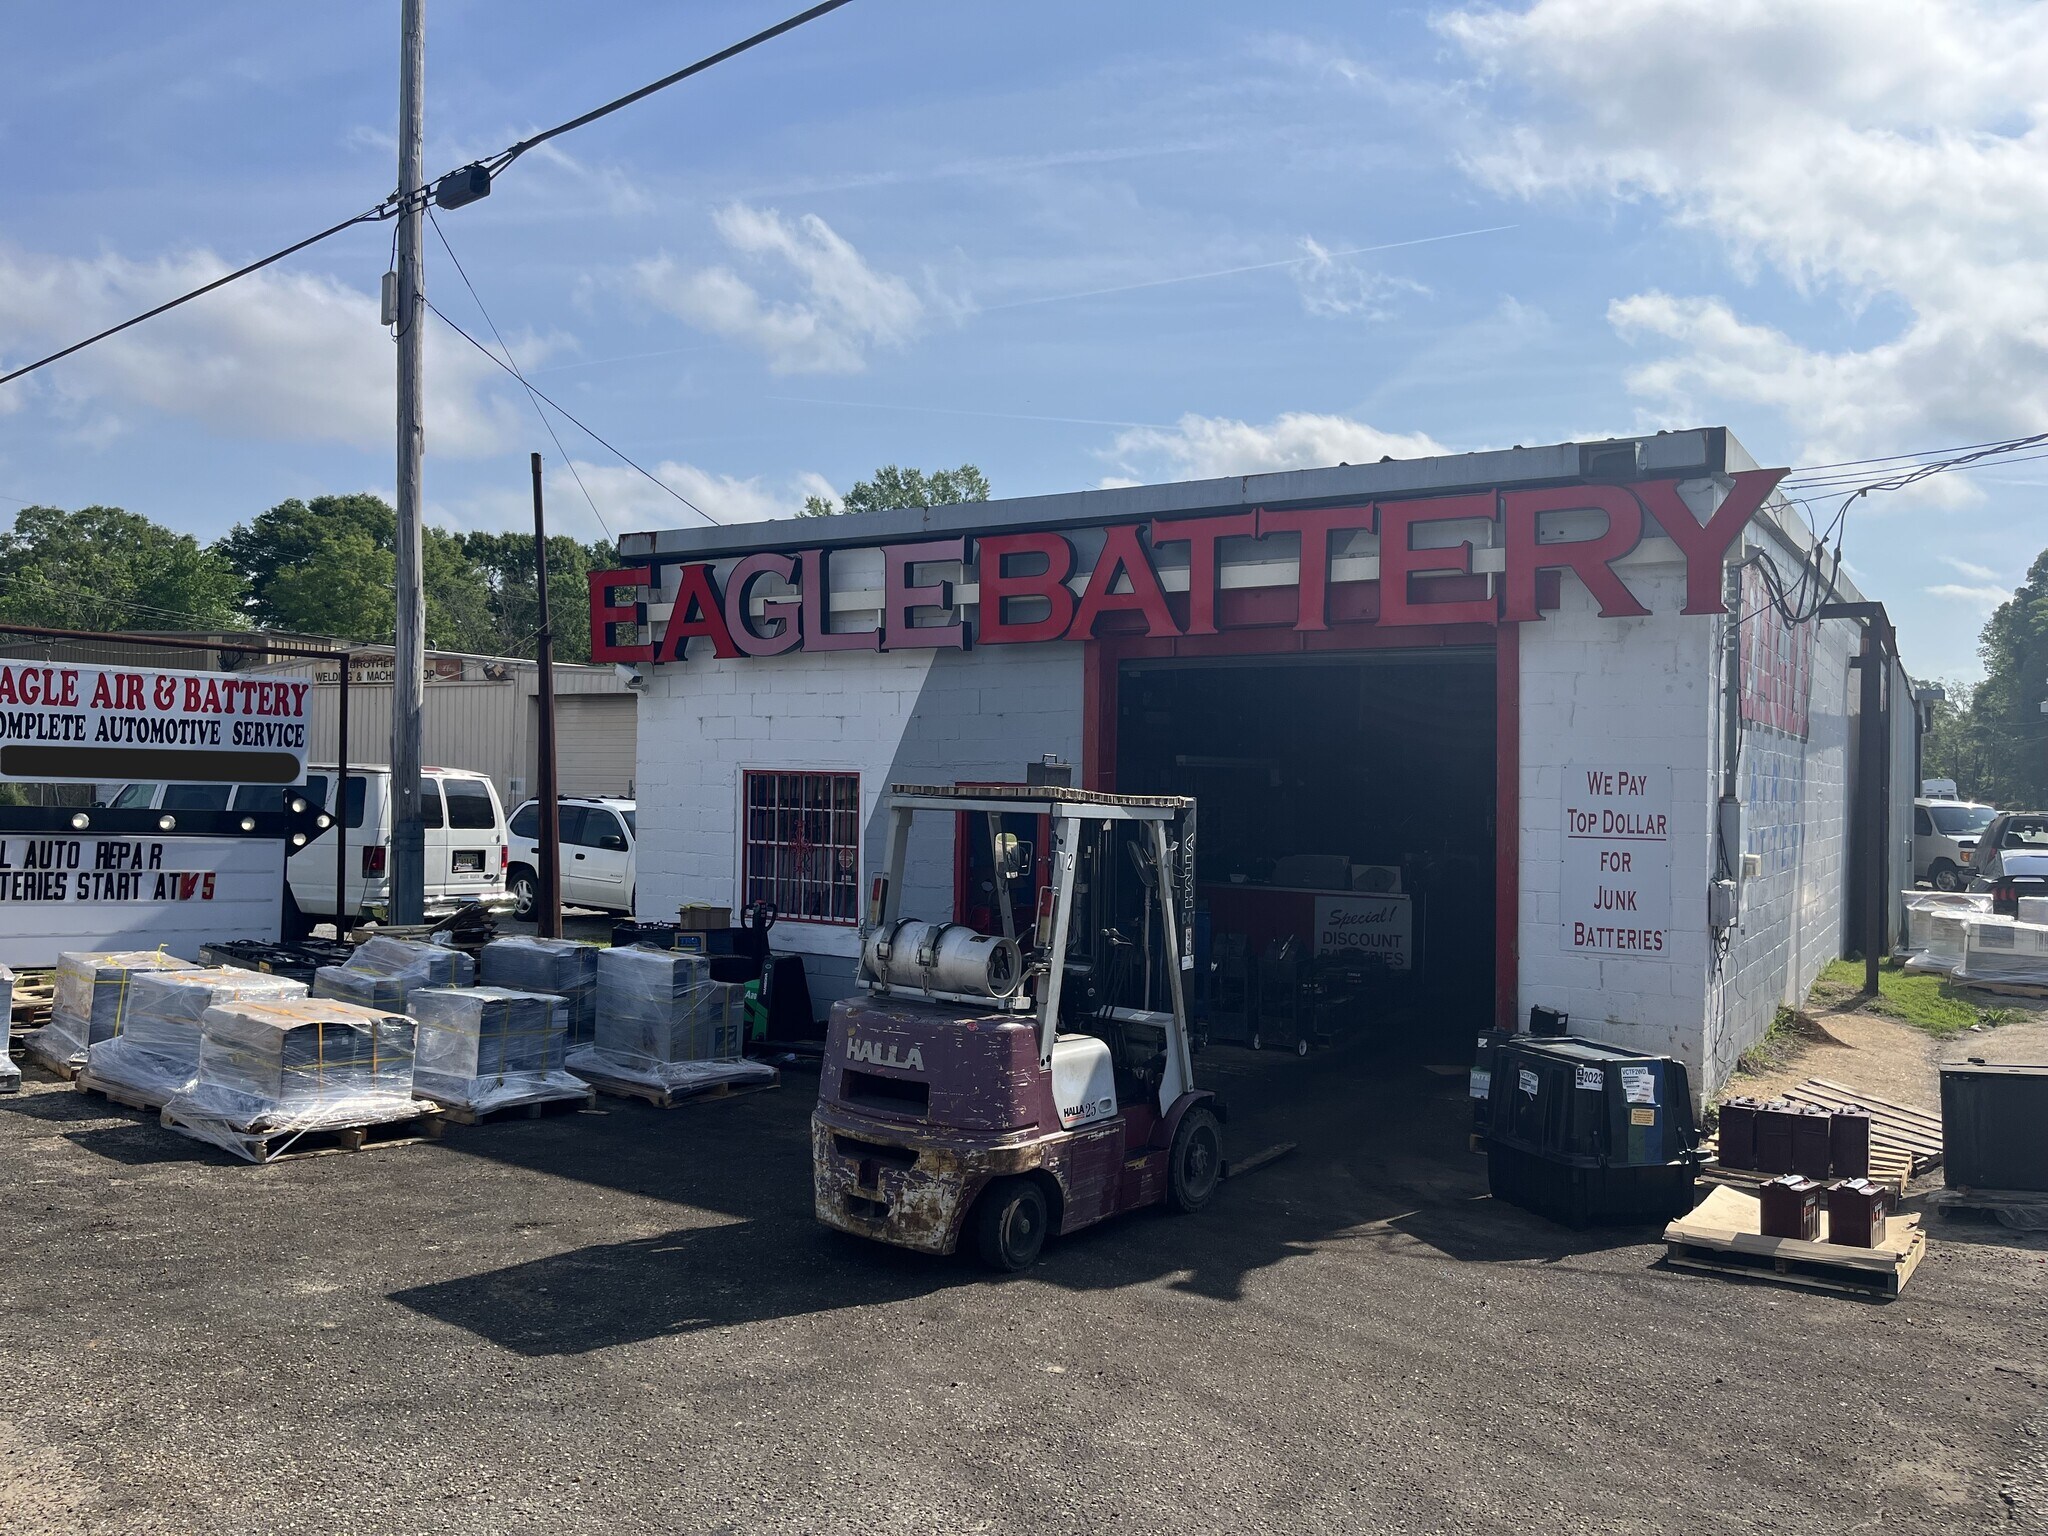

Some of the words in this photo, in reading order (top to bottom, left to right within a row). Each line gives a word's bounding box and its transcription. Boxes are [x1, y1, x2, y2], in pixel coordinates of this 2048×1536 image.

[587, 534, 972, 664] EAGLE
[975, 468, 1792, 645] BATTERY
[356, 671, 363, 682] &
[90, 673, 146, 711] AIR
[153, 675, 177, 711] &
[183, 677, 309, 717] BATTERY
[95, 715, 221, 746] AUTOMOTIVE
[233, 720, 305, 748] SERVICE
[1587, 771, 1613, 796] WE
[1618, 771, 1647, 796] PAY
[1567, 808, 1597, 833] TOP
[1603, 809, 1667, 835] DOLLAR
[24, 840, 80, 869] AUTO
[1067, 853, 1073, 871] 2
[1600, 851, 1631, 872] FOR
[0, 872, 67, 900] TERIES
[77, 873, 142, 900] START
[1594, 885, 1637, 911] JUNK
[1328, 906, 1397, 929] Special!
[1322, 931, 1402, 949] DISCOUNT
[1574, 922, 1663, 951] BATTERIES
[846, 1037, 925, 1072] HALLA
[1584, 1071, 1603, 1085] 2023
[1063, 1104, 1085, 1117] HALLA
[1085, 1101, 1097, 1118] 25
